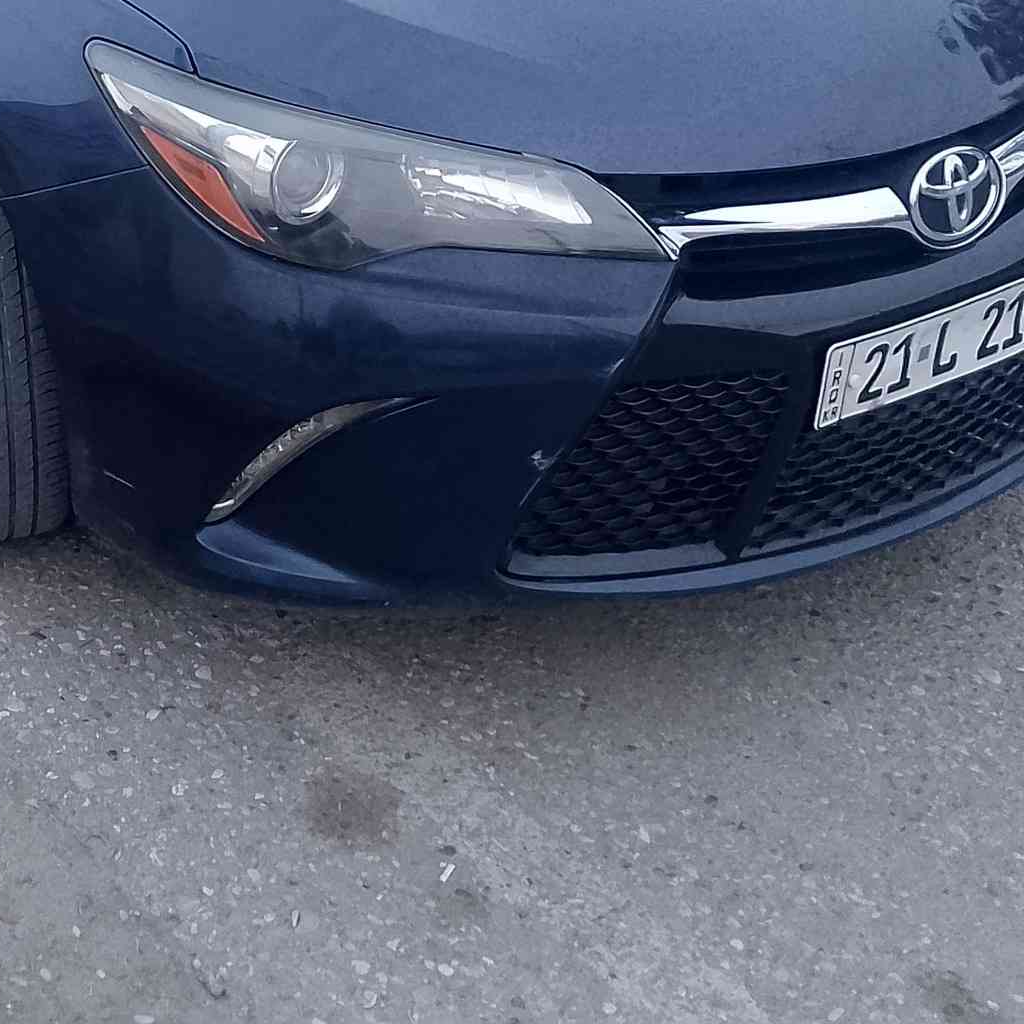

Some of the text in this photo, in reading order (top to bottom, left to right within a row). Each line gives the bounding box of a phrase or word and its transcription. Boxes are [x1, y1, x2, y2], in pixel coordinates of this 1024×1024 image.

[857, 291, 1024, 404] 21 L 21
